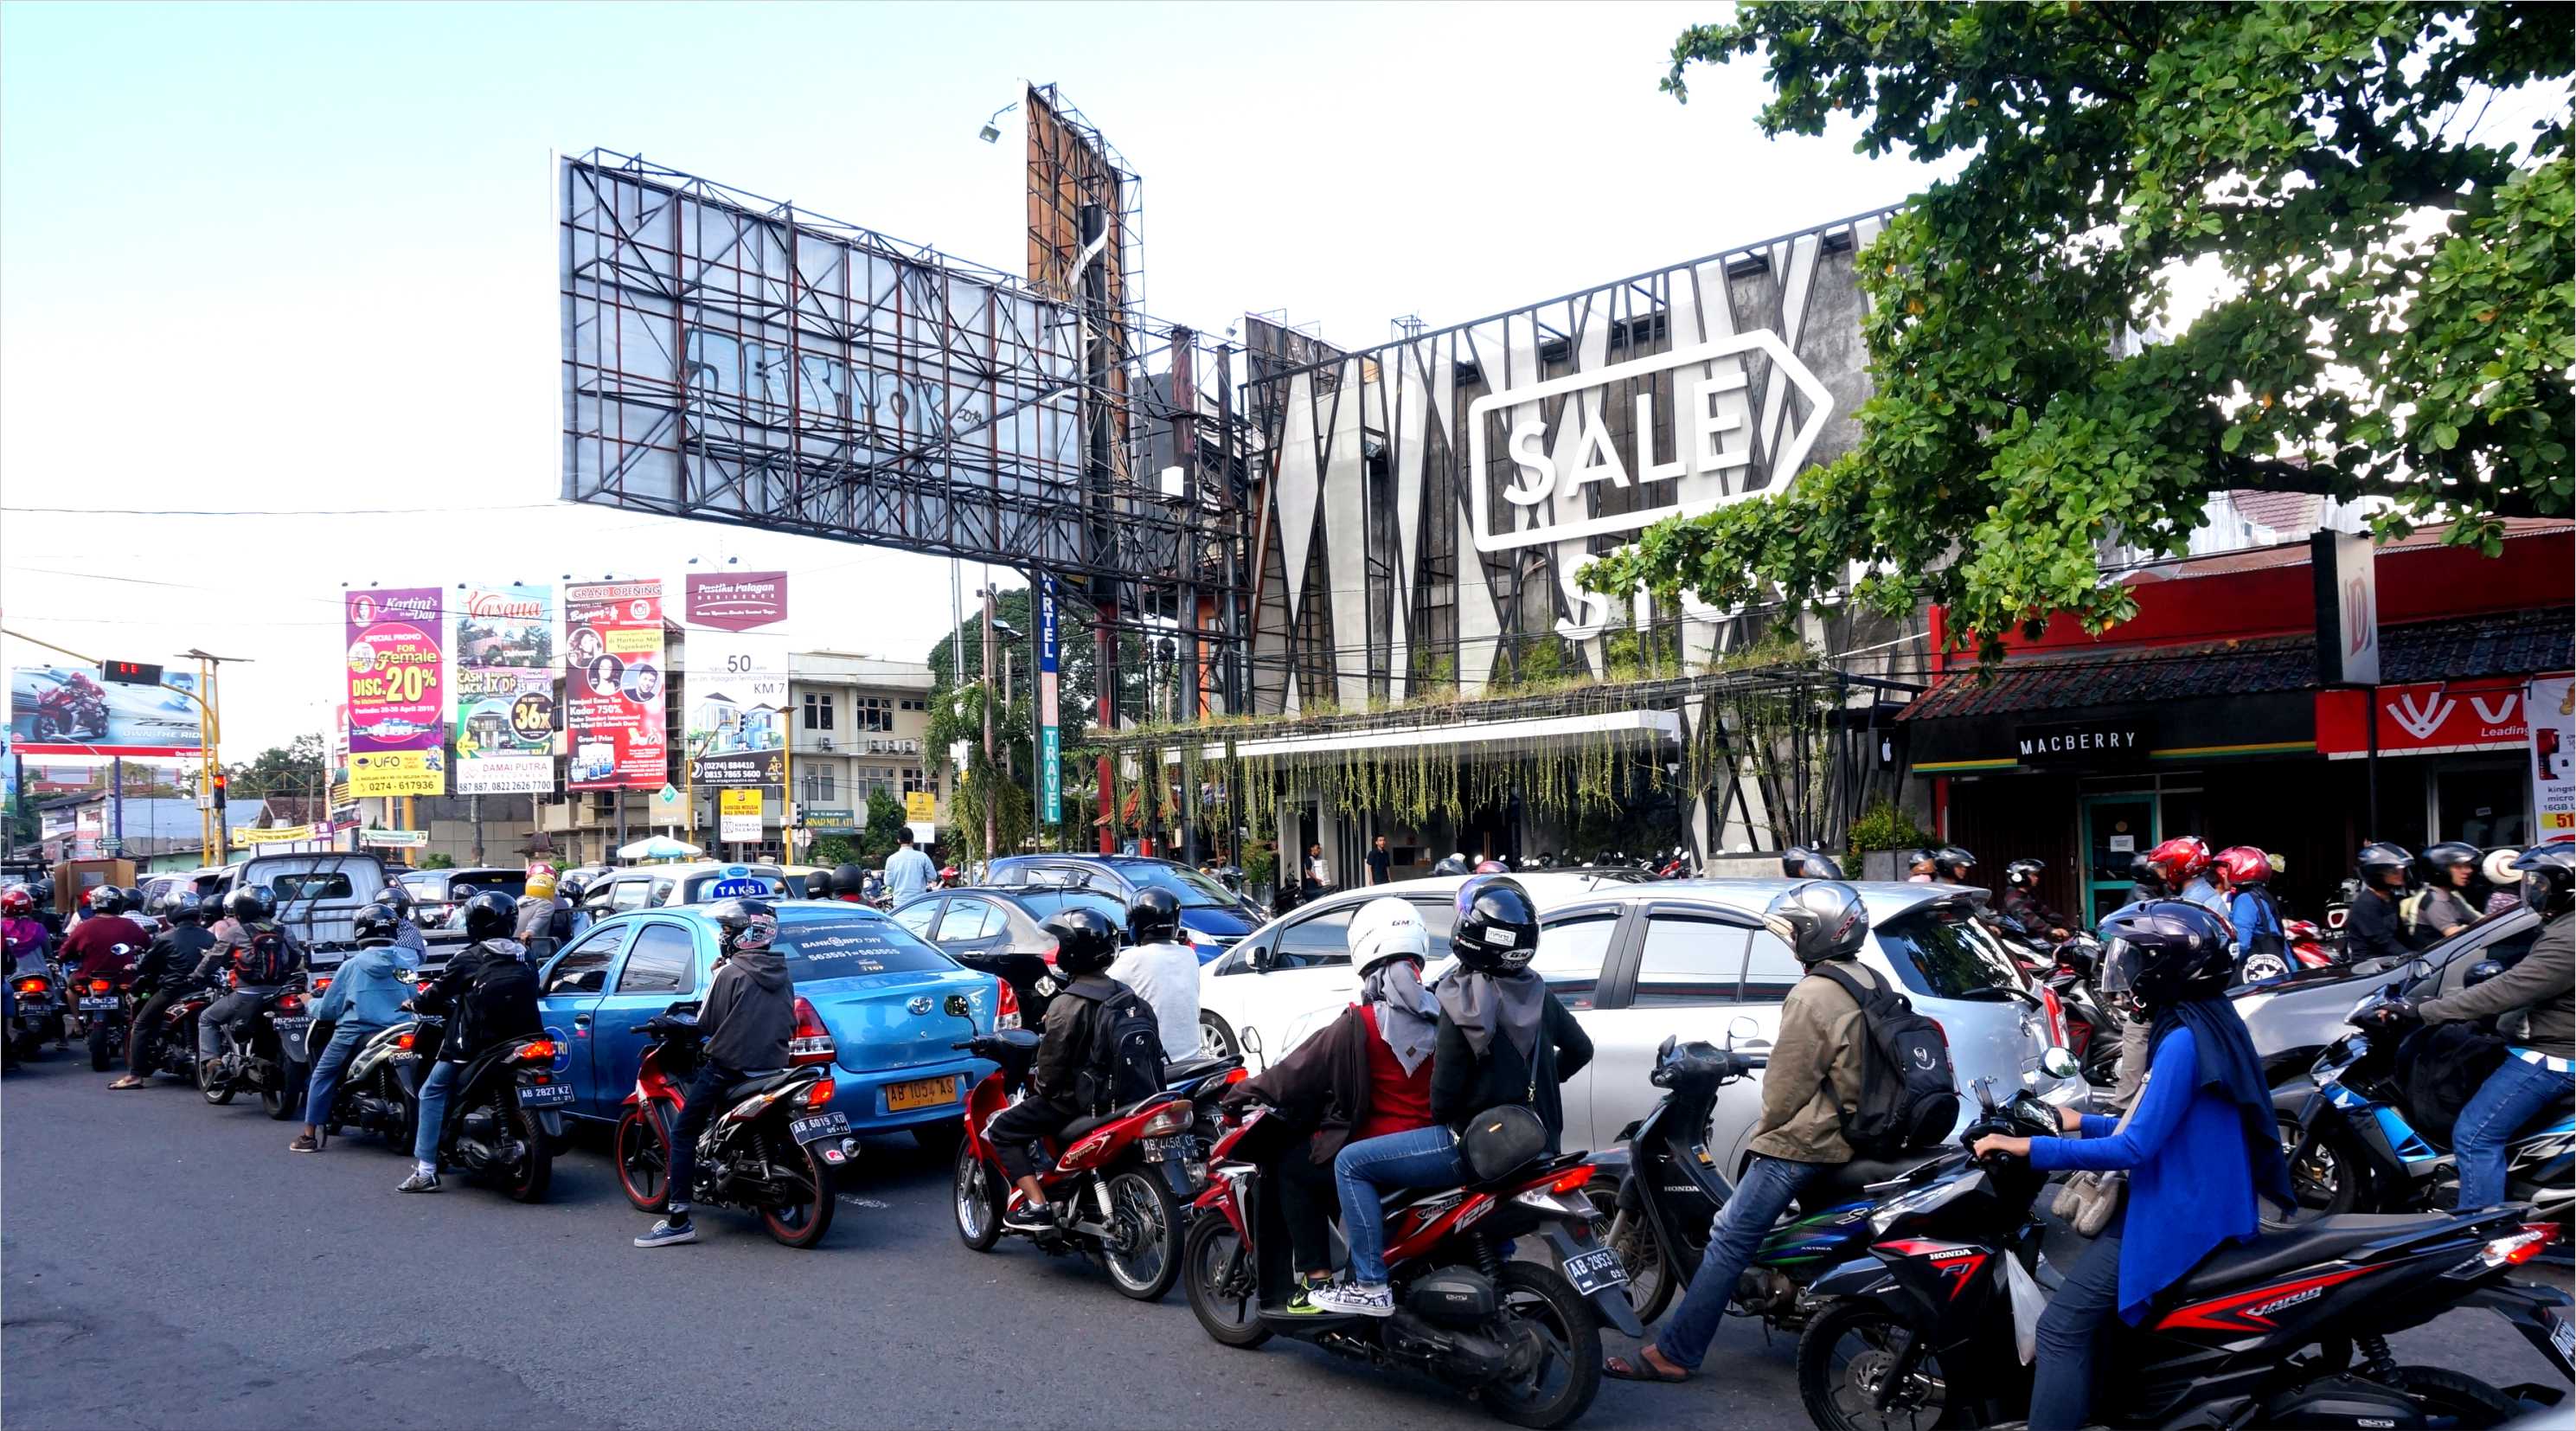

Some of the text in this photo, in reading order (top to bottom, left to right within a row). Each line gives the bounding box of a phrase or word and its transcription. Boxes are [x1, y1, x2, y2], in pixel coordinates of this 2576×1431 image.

[1503, 371, 1751, 506] SALE
[573, 585, 662, 598] GRAND OPENING
[410, 609, 435, 621] Day
[375, 648, 437, 671] Female
[727, 655, 751, 672] 50
[458, 672, 483, 683] CASH
[352, 678, 386, 696] DISC.
[386, 665, 437, 703] 20%
[458, 683, 484, 694] BACK
[754, 683, 785, 694] KM 7
[569, 706, 595, 716] Kadar
[542, 742, 551, 754] 7
[2020, 732, 2136, 755] MACBERRY
[374, 756, 400, 767] UFO
[704, 761, 727, 770] (0274)
[1046, 731, 1058, 822] TRAVEL
[399, 781, 434, 790] 617936
[492, 782, 510, 791] 0822
[512, 781, 530, 790] 2626
[533, 781, 551, 790] 7700
[719, 885, 761, 895] TAKSI
[801, 940, 830, 948] BANK
[522, 1086, 570, 1098] AB 2827 KZ
[891, 1087, 905, 1101] AB
[940, 1079, 954, 1095] AS
[793, 1122, 807, 1133] AB
[809, 1118, 830, 1128] 6019
[1144, 1135, 1195, 1151] AB 4458 CF
[1454, 1195, 1496, 1234] 125
[1929, 1249, 1972, 1261] HONDA
[1570, 1253, 1612, 1278] AB 2953
